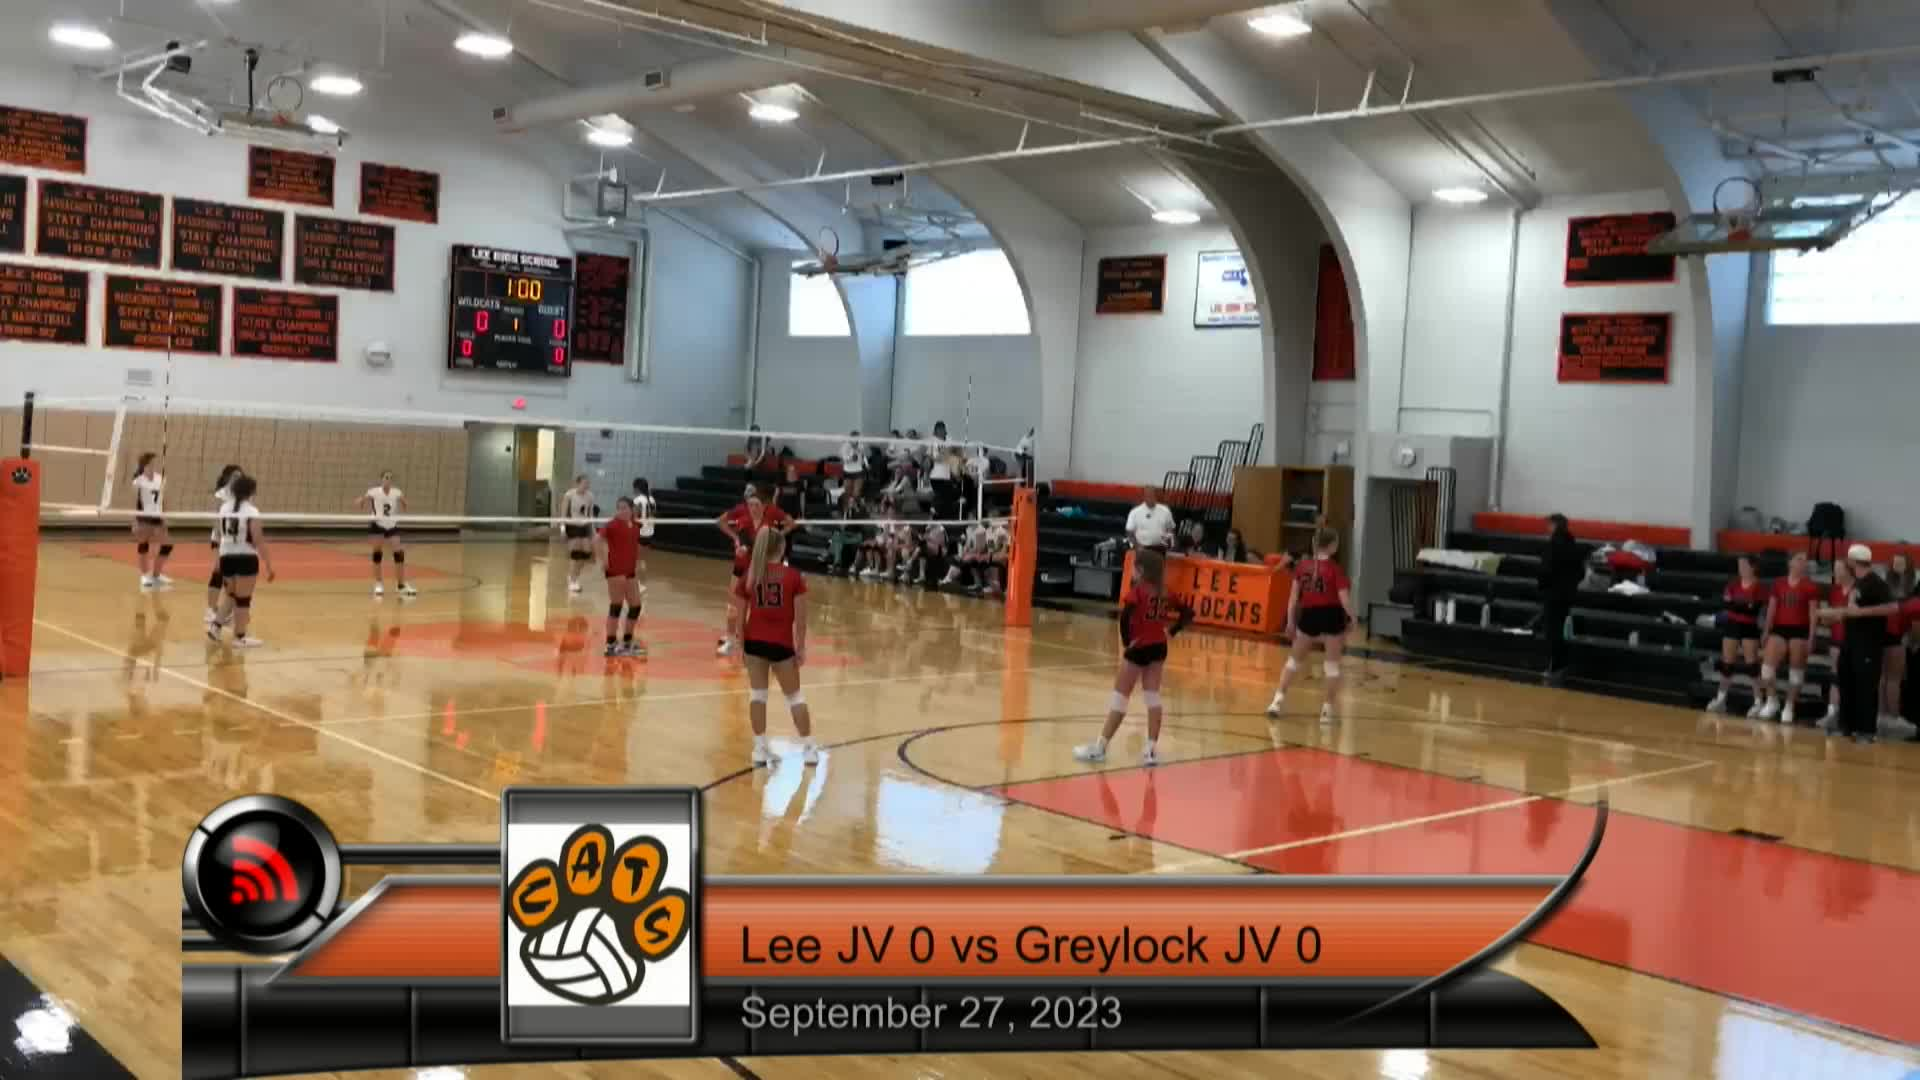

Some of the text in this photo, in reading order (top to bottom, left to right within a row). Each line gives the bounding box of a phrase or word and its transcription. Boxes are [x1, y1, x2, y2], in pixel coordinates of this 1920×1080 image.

[48, 212, 83, 226] STATE
[85, 231, 151, 249] BASKETBALL
[180, 229, 213, 243] STATE
[216, 245, 272, 263] BASKETBALL
[471, 247, 491, 260] LEE
[493, 250, 518, 263] HIGH
[520, 254, 560, 269] SCHOOL
[31, 271, 64, 281] HIGH
[457, 296, 500, 309] WILDCATS
[475, 310, 489, 333] 0
[462, 339, 473, 356] 0
[554, 347, 566, 364] 0
[1193, 567, 1239, 594] LEE
[756, 583, 783, 607] 13
